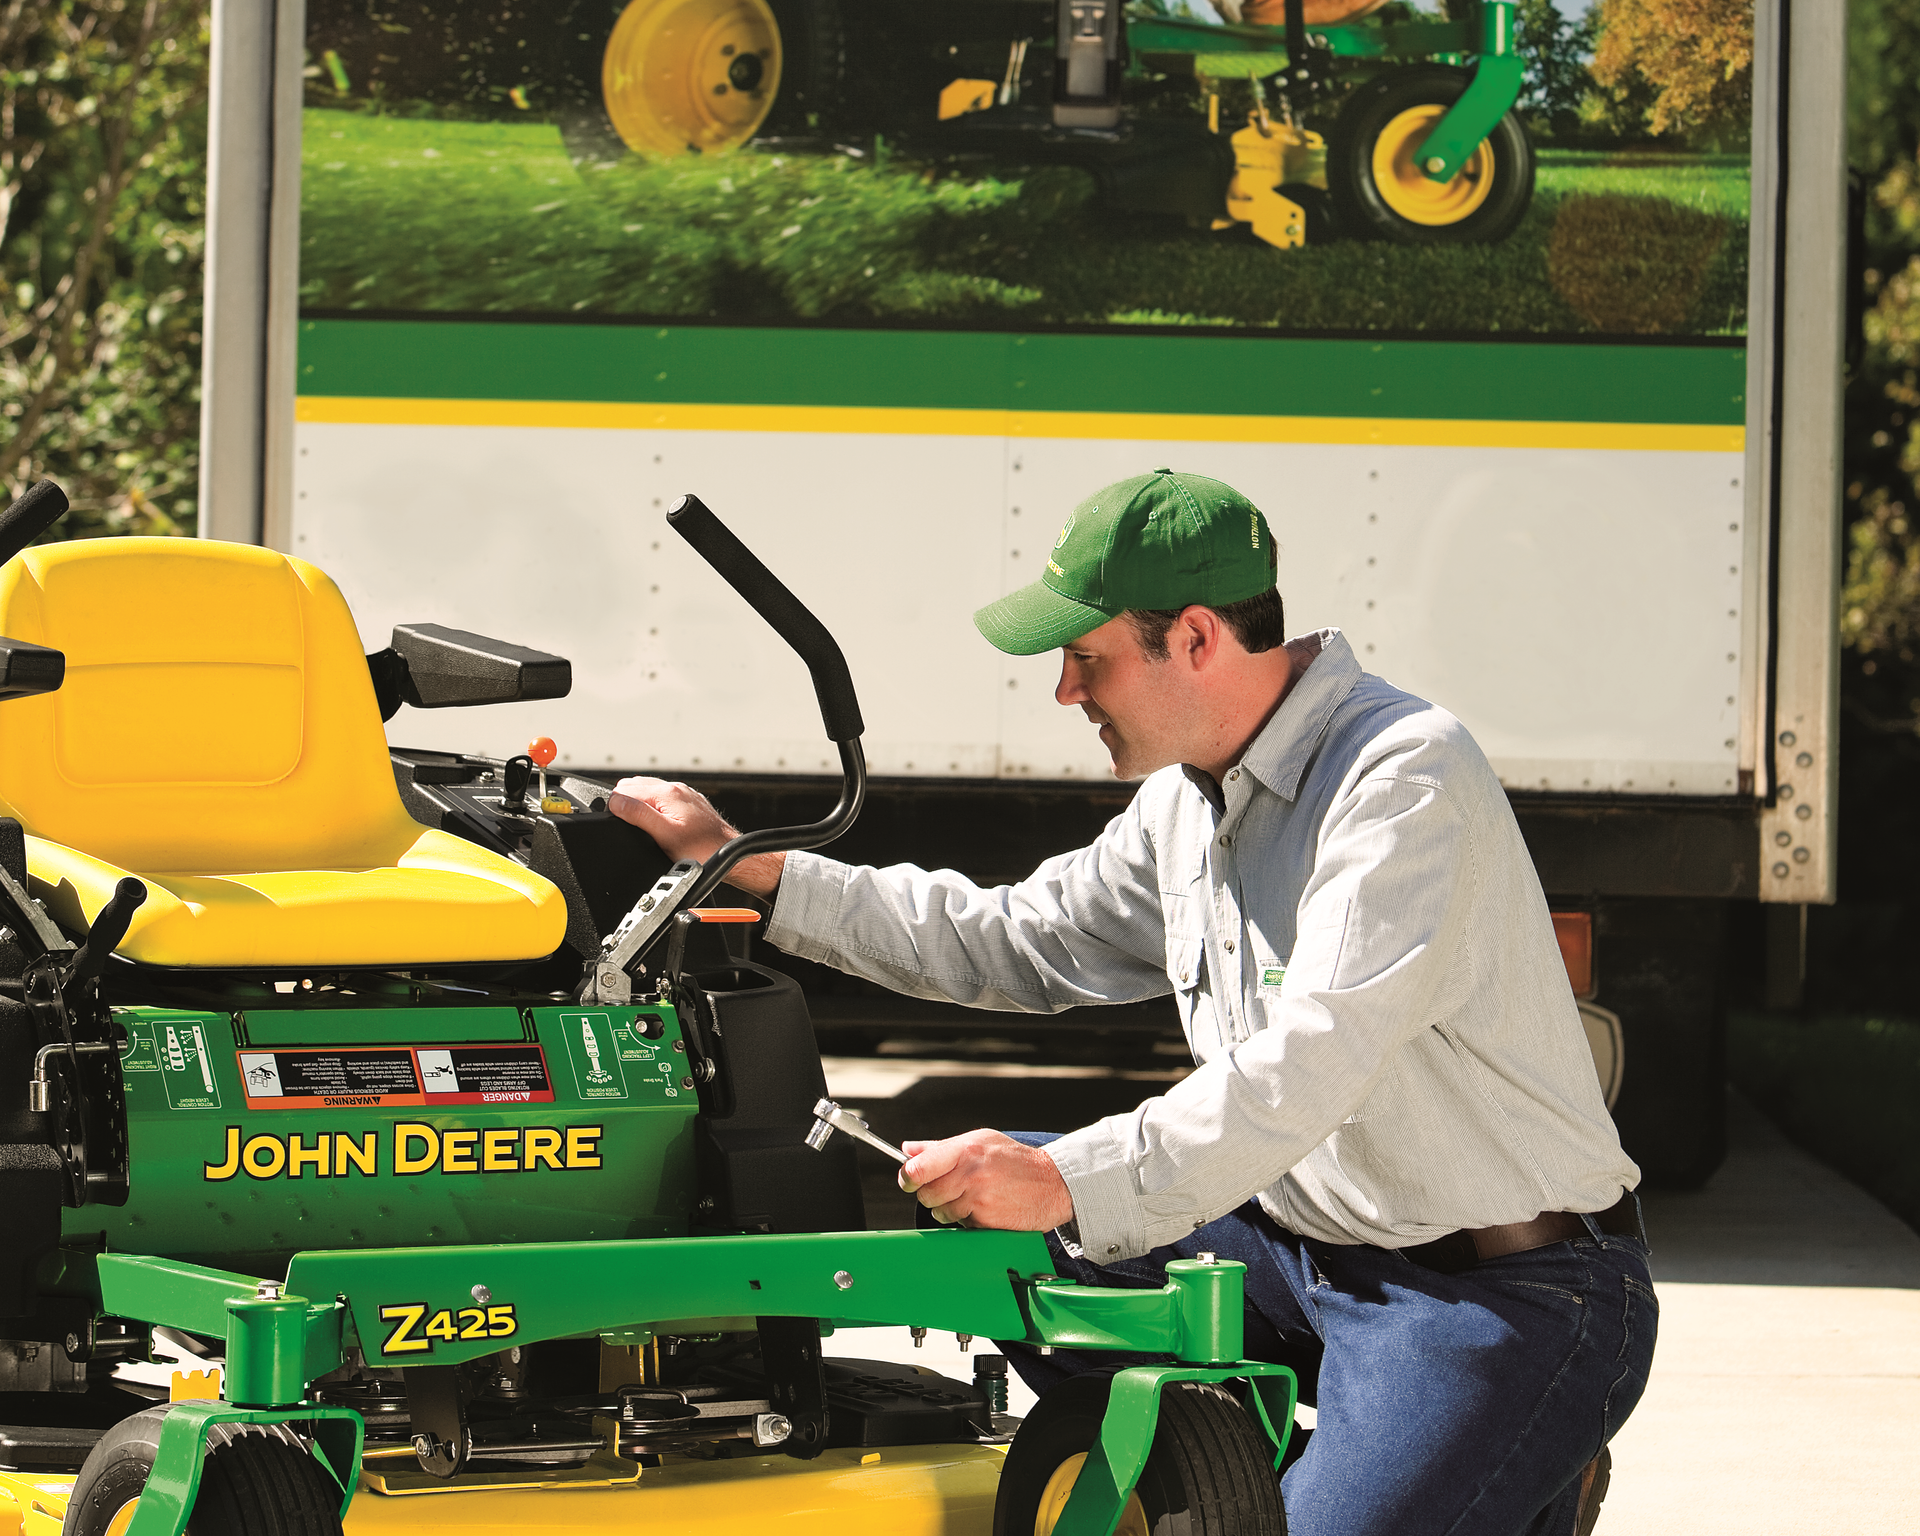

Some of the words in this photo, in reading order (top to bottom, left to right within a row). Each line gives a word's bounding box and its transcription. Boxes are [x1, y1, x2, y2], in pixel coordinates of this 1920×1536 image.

[1250, 513, 1260, 549] NOTHING
[324, 1097, 372, 1105] WARNING
[482, 1092, 521, 1101] DANGER
[204, 1125, 379, 1182] JOHN
[393, 1121, 603, 1176] DEERE
[378, 1302, 519, 1356] Z425
